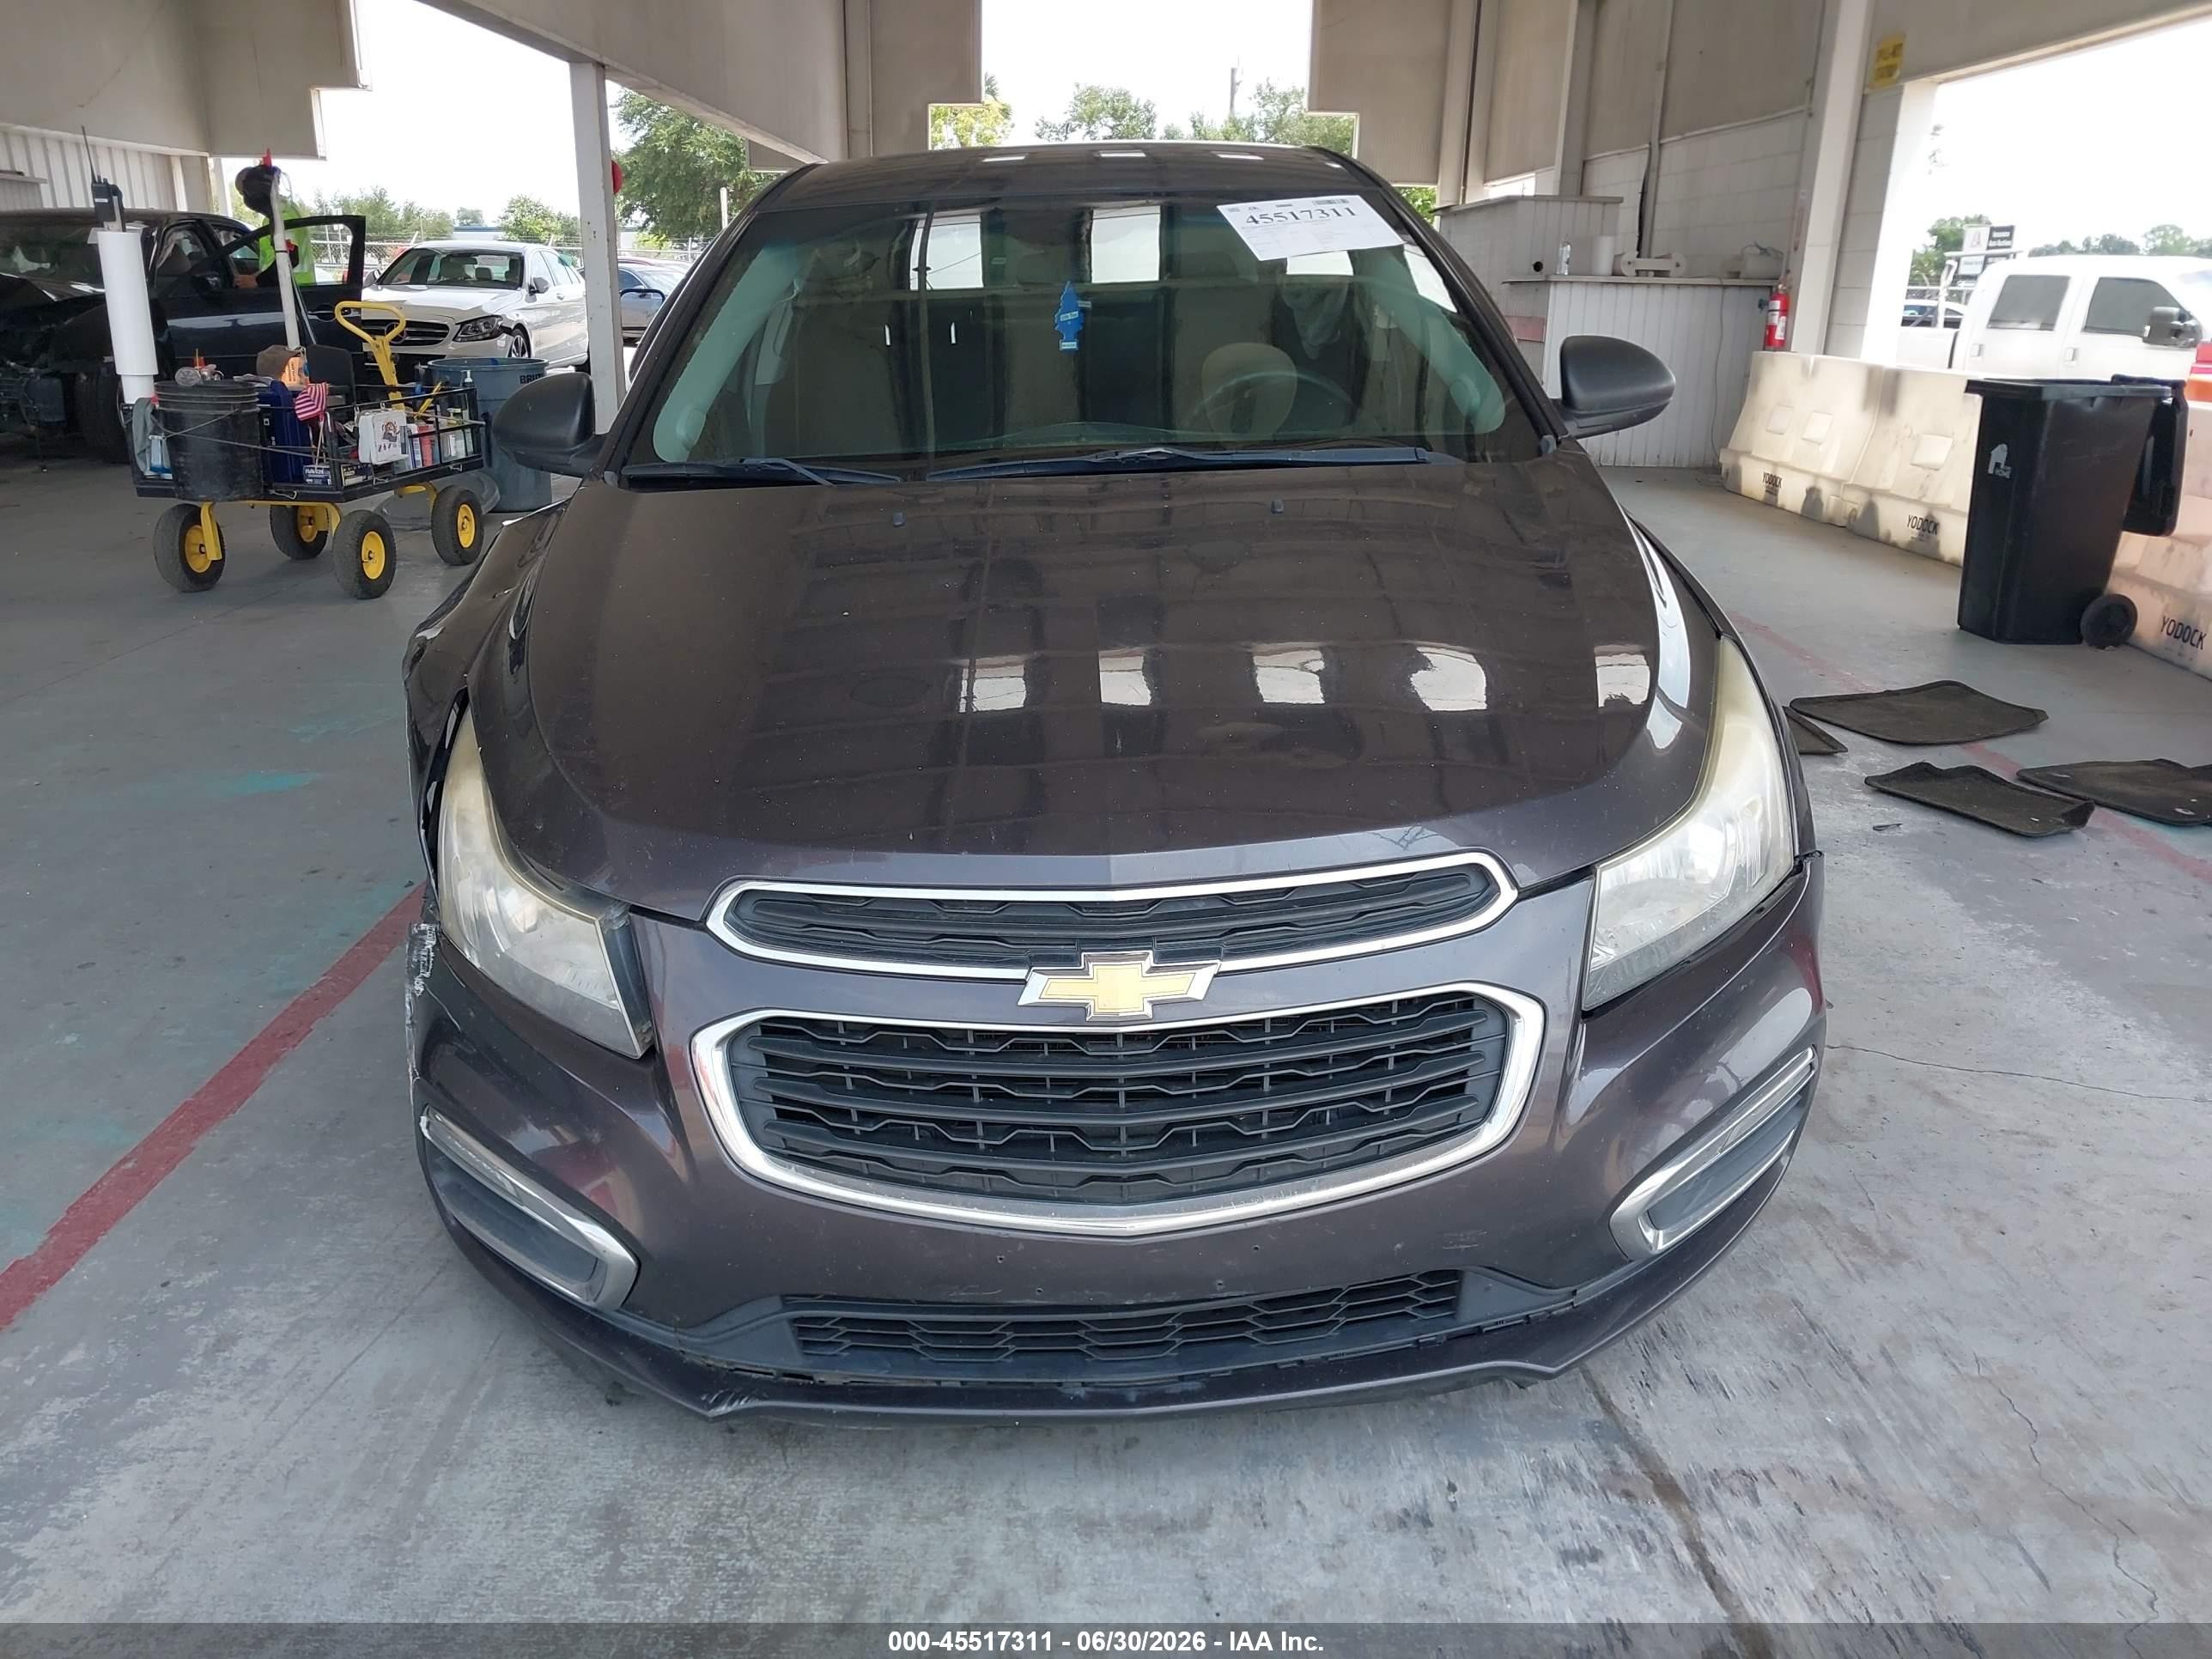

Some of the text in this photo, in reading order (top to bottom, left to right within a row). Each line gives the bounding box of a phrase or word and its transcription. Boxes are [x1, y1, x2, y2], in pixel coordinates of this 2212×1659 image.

[1246, 206, 1356, 225] 45517311
[1762, 471, 1783, 488] YODOCK
[1907, 514, 1939, 535] YODOCK
[2160, 615, 2207, 650] YODOCK
